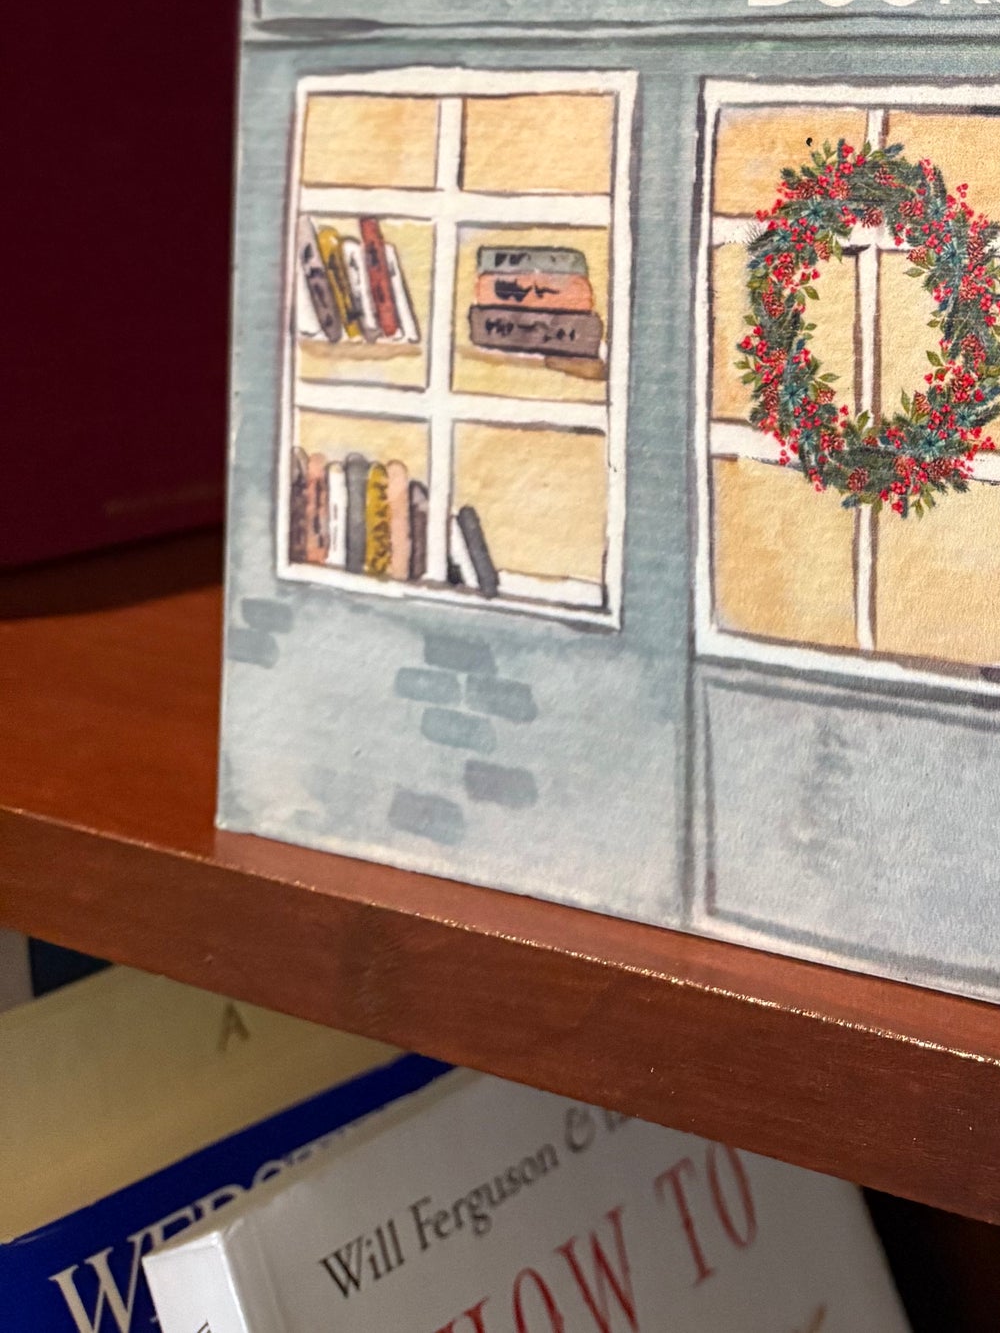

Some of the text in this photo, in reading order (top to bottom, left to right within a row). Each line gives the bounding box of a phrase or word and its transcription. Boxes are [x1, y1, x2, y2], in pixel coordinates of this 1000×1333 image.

[319, 1218, 405, 1299] Will
[408, 1143, 560, 1252] Ferguson
[653, 1142, 757, 1288] TO
